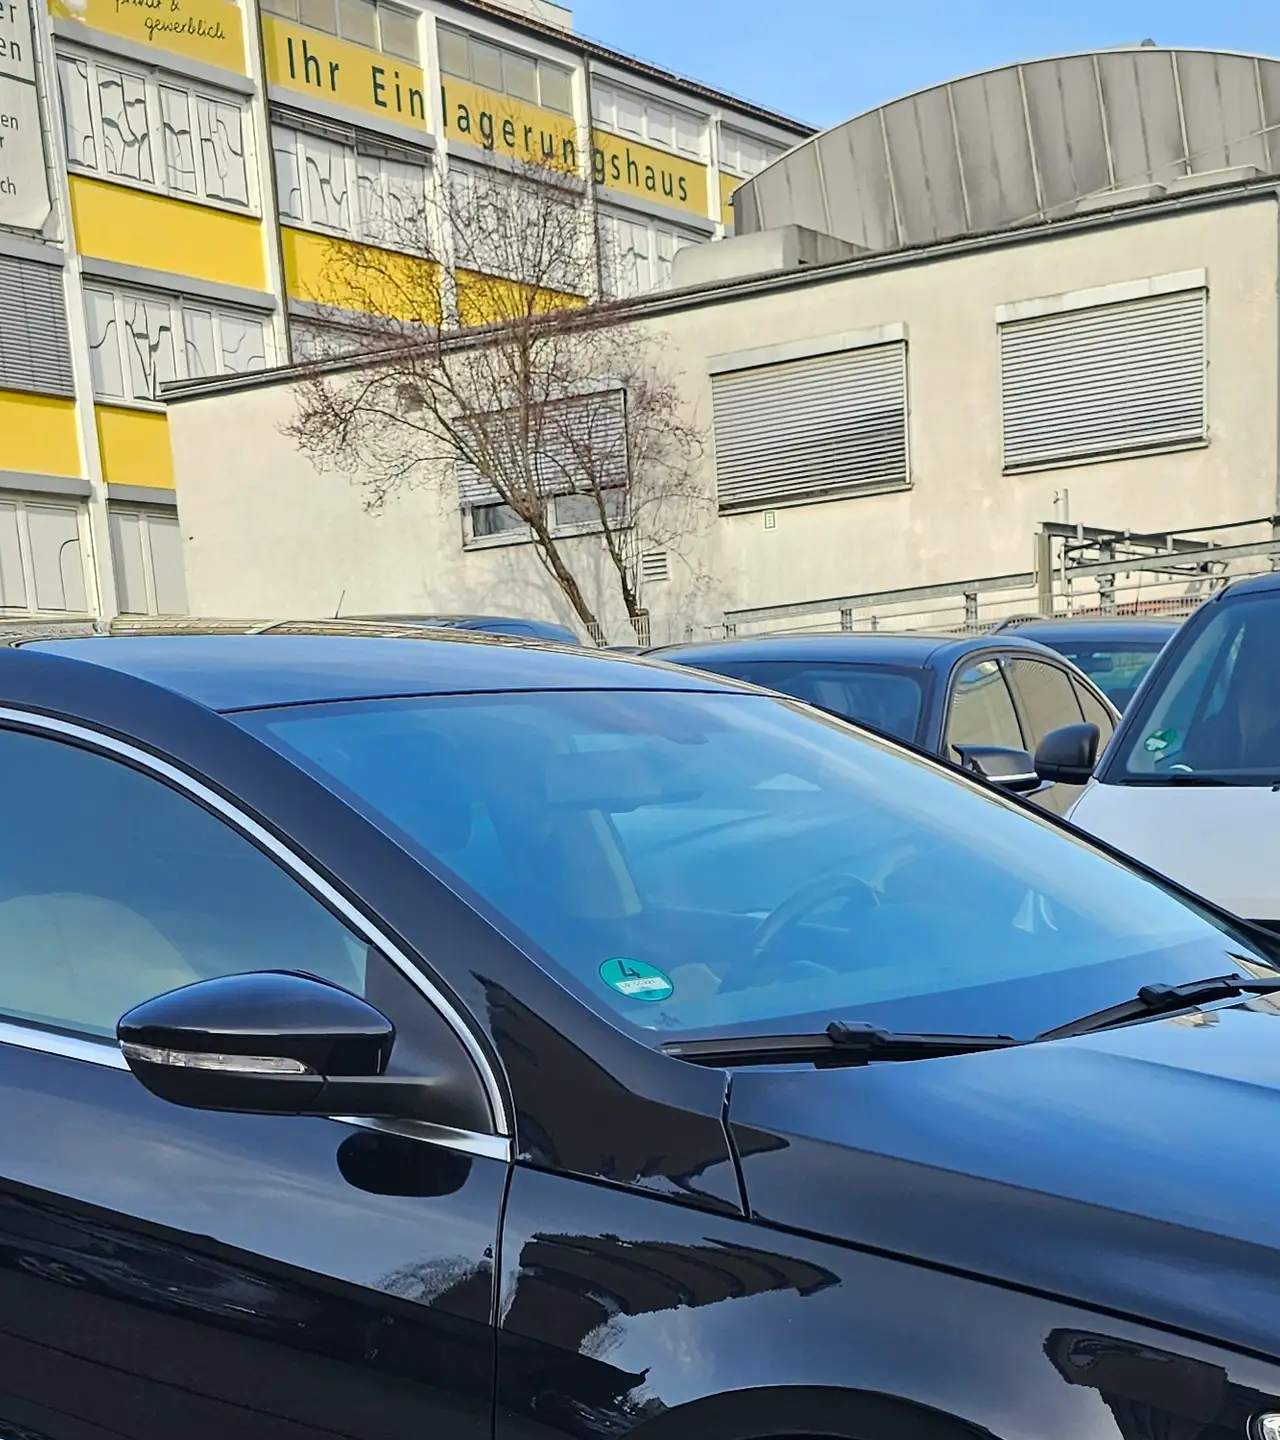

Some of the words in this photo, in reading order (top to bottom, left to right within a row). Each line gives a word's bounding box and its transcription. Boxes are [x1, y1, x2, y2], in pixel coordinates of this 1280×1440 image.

[144, 17, 225, 41] gewerblich
[287, 37, 339, 92] Ihr
[617, 959, 642, 978] 4
